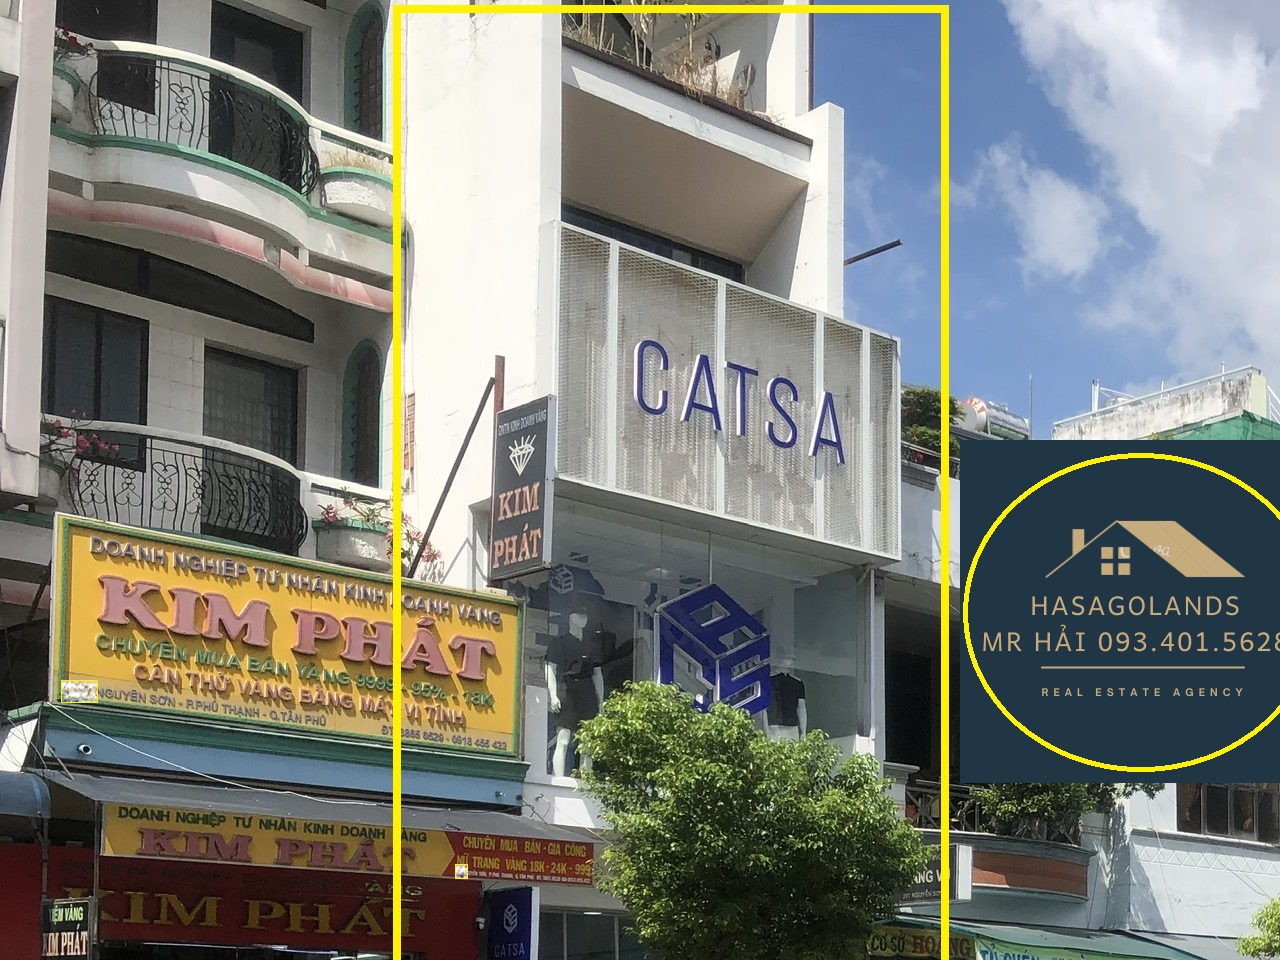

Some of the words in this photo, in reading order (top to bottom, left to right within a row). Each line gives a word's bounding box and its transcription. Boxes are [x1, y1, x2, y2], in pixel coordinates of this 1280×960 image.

[633, 340, 846, 465] CATSA
[498, 481, 541, 521] KIM
[493, 522, 541, 568] PHÁT
[89, 536, 166, 564] DOANH
[172, 552, 247, 583] NGHIỆP
[253, 566, 279, 585] TƯ
[285, 574, 337, 597] NHÂN
[344, 583, 387, 605] KINH
[390, 592, 450, 617] OANH
[457, 602, 502, 625] VÀNG
[98, 575, 271, 647] KIM
[290, 608, 497, 681] PHÁT
[96, 634, 187, 662] CHUYÊN
[194, 651, 241, 670] MUA
[247, 655, 290, 676] BÁN
[296, 663, 350, 685] VÀNG
[133, 663, 180, 687] CÂN
[237, 678, 293, 701] VÀNG
[298, 685, 354, 709] BẰNG
[404, 703, 421, 719] VI
[425, 704, 465, 726] TÍNH
[150, 694, 176, 708] SƠN
[305, 712, 327, 727] PHÚ
[117, 806, 171, 822] DOANH
[175, 811, 227, 828] NGHIỆP
[234, 815, 253, 829] TƯ
[259, 818, 298, 833] NHÂN
[303, 822, 335, 836] KINH
[340, 825, 386, 840] DOANH
[401, 828, 427, 843] ÀNG
[137, 827, 253, 864] KIM
[276, 836, 417, 875] PHÁT
[462, 835, 496, 851] CHUYÊN
[500, 839, 518, 853] MUA
[524, 841, 541, 855] BÁN
[547, 843, 561, 856] GIA
[564, 844, 587, 858] CÔNG
[472, 856, 500, 870] TRANG
[505, 856, 527, 872] VÀNG
[529, 861, 545, 873] 18K
[551, 862, 567, 874] 24K
[64, 903, 84, 922] VÀNG
[242, 896, 426, 938] PHÁT
[60, 923, 88, 956] PHÁT
[494, 943, 525, 959] CATSA
